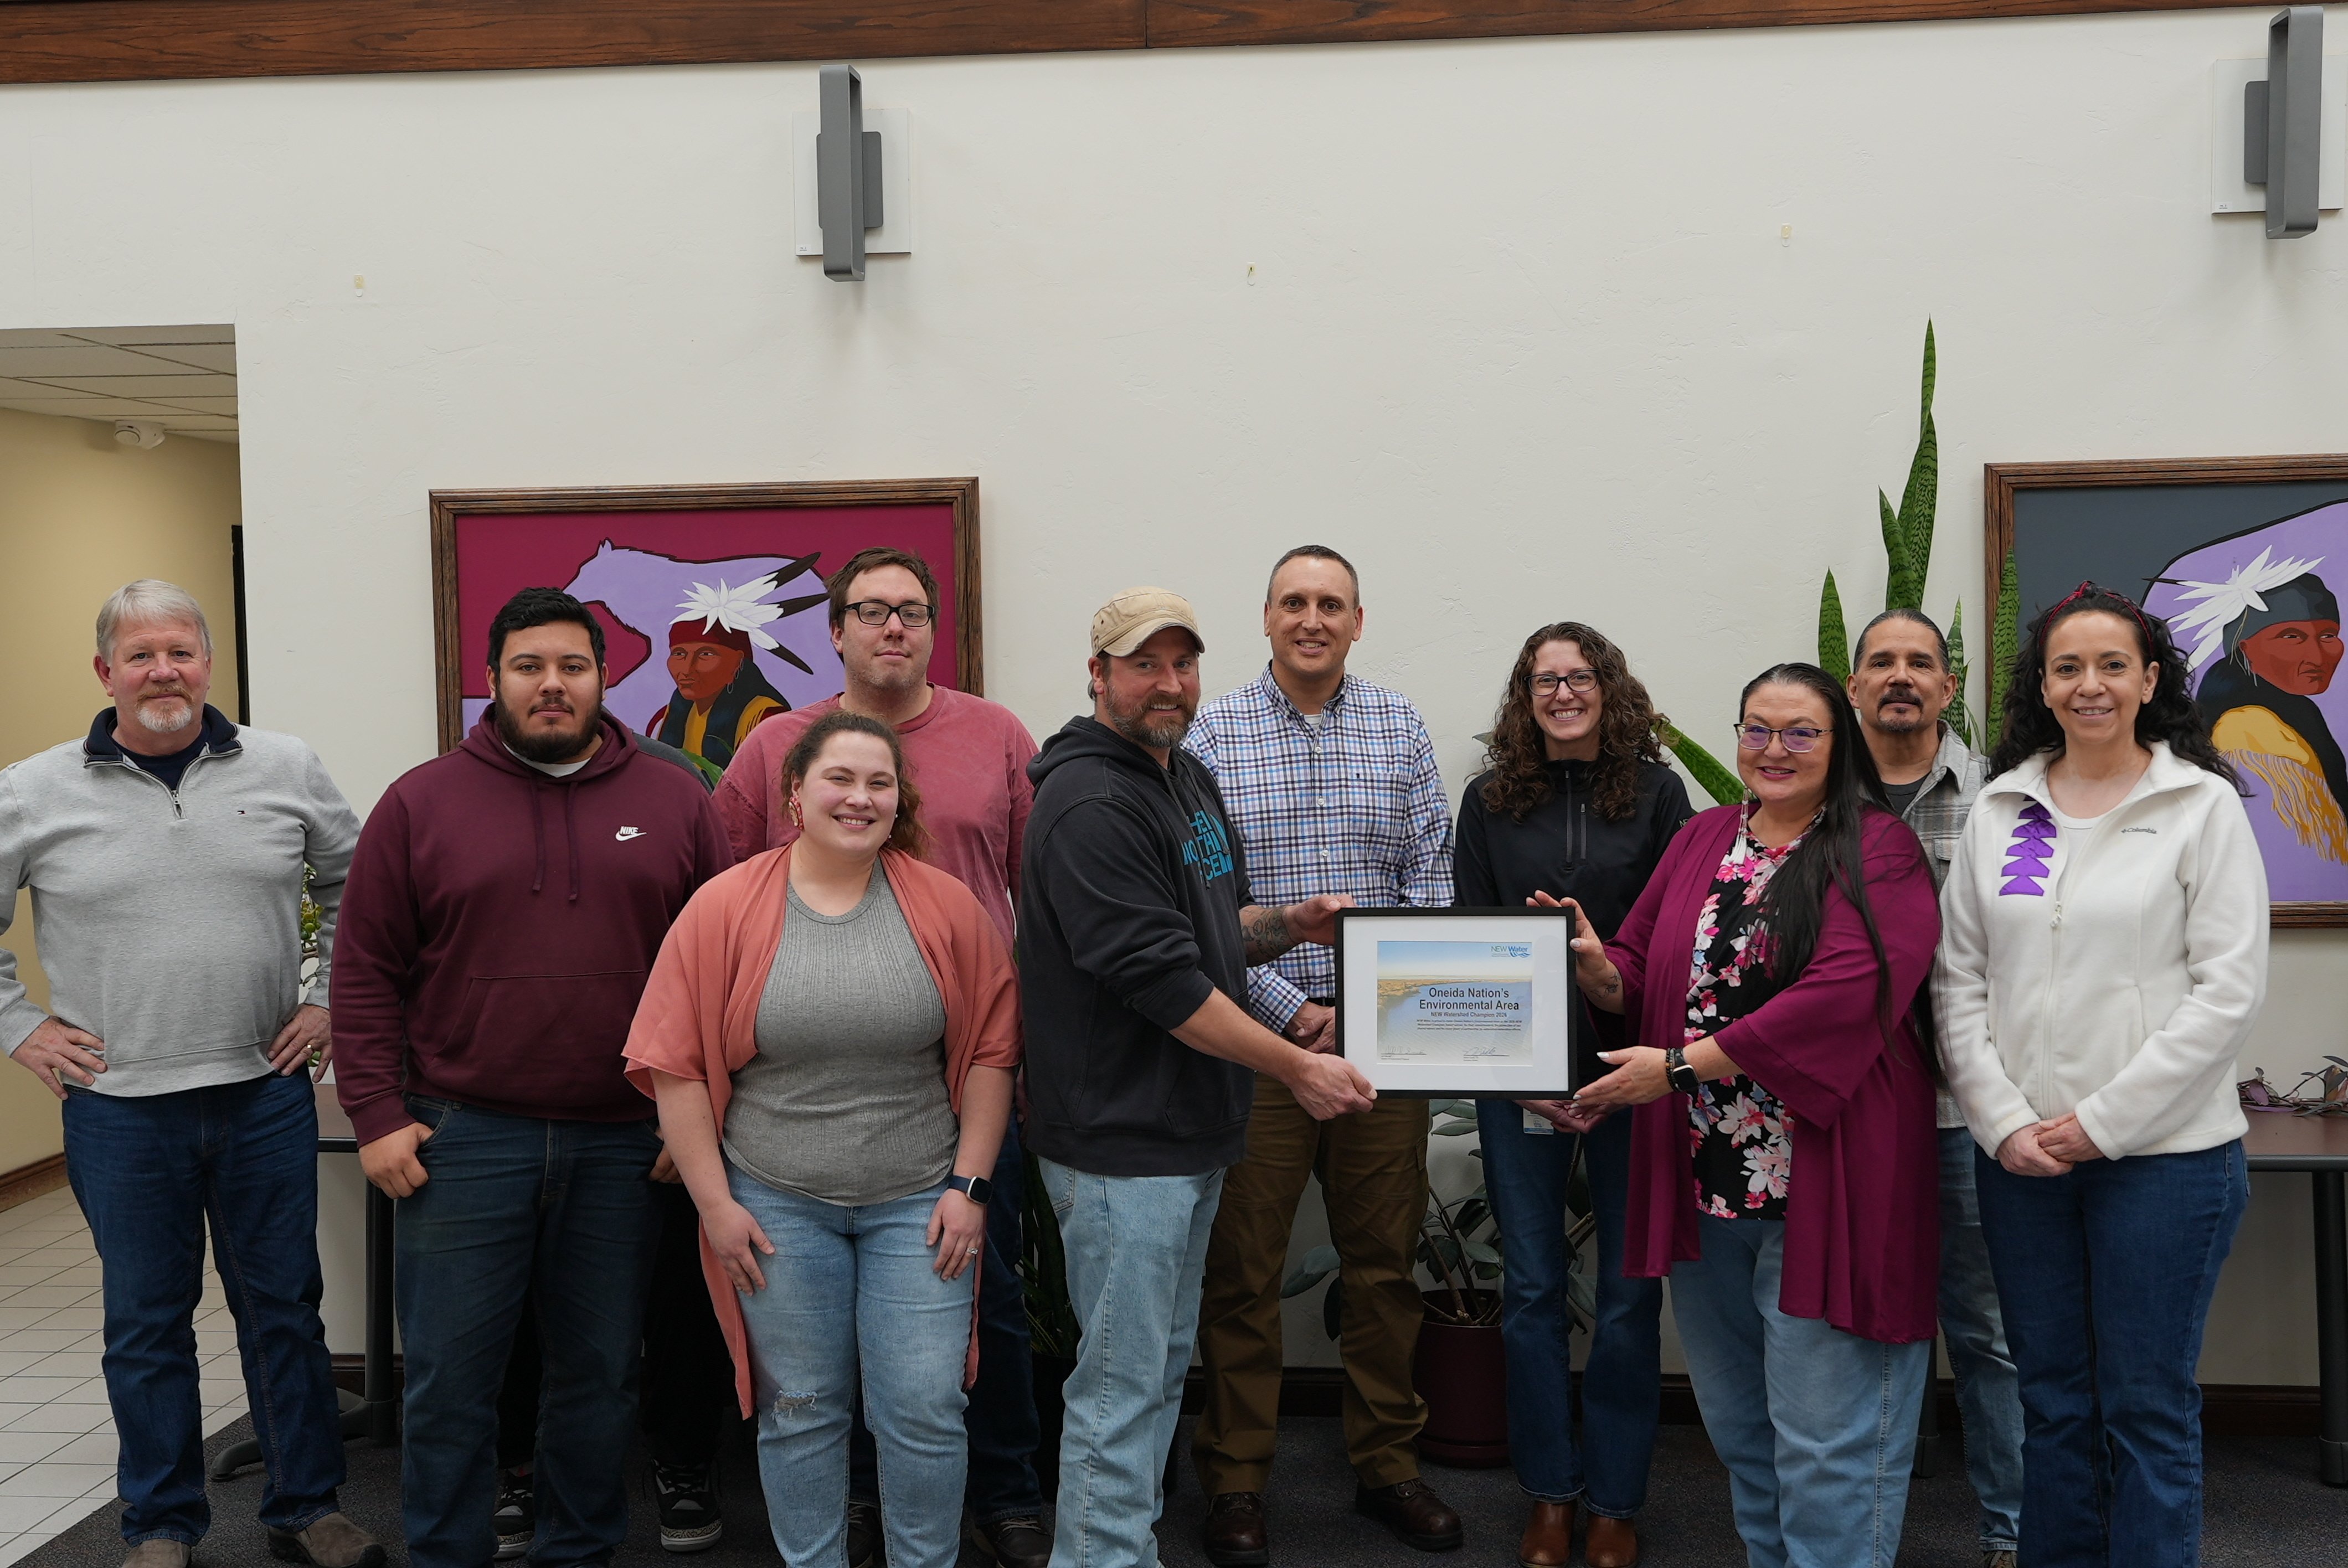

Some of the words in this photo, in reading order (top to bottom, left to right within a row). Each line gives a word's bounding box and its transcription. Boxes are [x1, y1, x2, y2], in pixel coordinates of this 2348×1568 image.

[620, 826, 639, 835] NIKE
[1429, 987, 1464, 997] Oneida
[1468, 988, 1509, 998] Nation's
[1419, 999, 1492, 1009] Environmental
[1496, 1000, 1519, 1010] Area
